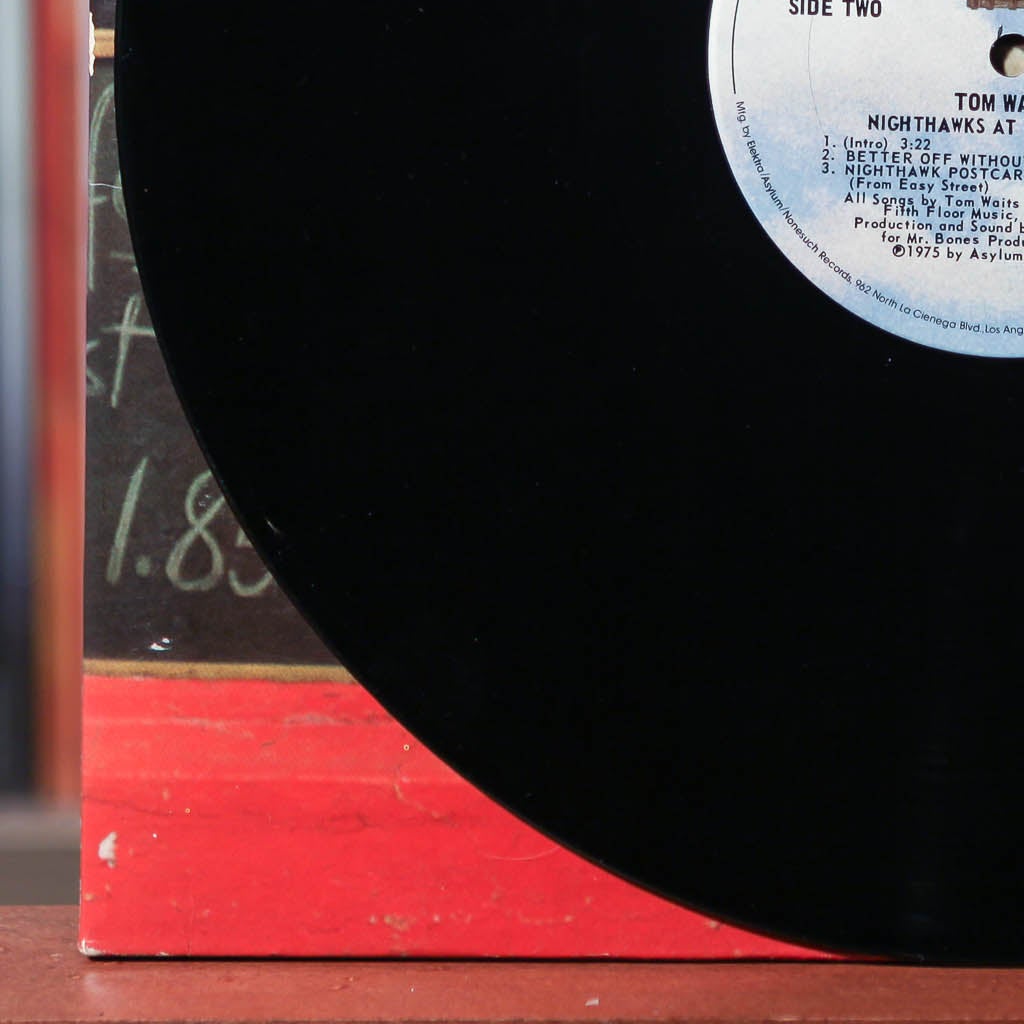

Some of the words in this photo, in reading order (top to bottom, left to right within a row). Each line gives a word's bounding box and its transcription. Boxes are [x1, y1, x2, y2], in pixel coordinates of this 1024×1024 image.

[955, 92, 996, 112] TOM
[868, 114, 985, 135] NIGHTHAWKS
[993, 119, 1016, 135] AT
[824, 135, 836, 148] 1.
[843, 136, 888, 151] (Intro)
[900, 138, 931, 151] 3:22
[822, 149, 835, 161] 2.
[846, 150, 913, 164] BETTER
[920, 153, 952, 165] OFF
[821, 162, 835, 175] 3.
[845, 164, 941, 178] NIGHTHAWK
[850, 177, 892, 191] (From
[900, 178, 935, 193] Easy
[941, 179, 989, 194] Street)
[844, 192, 866, 204] All
[872, 193, 914, 208] Songs
[921, 194, 937, 208] by
[945, 195, 975, 207] Tom
[981, 196, 1019, 209] Waits
[884, 204, 919, 217] Fifth
[926, 205, 965, 219] Floor
[971, 207, 1018, 222] Music,
[854, 217, 933, 230] Production
[939, 220, 964, 233] and
[970, 221, 1012, 234] Sound
[881, 231, 901, 243] for
[907, 232, 928, 245] Mr.
[935, 232, 980, 245] Bones
[947, 247, 962, 262] by
[969, 248, 1023, 263] Asylum
[855, 279, 872, 295] 962
[872, 289, 898, 310] North
[900, 304, 912, 316] La
[913, 309, 957, 330] Cienega
